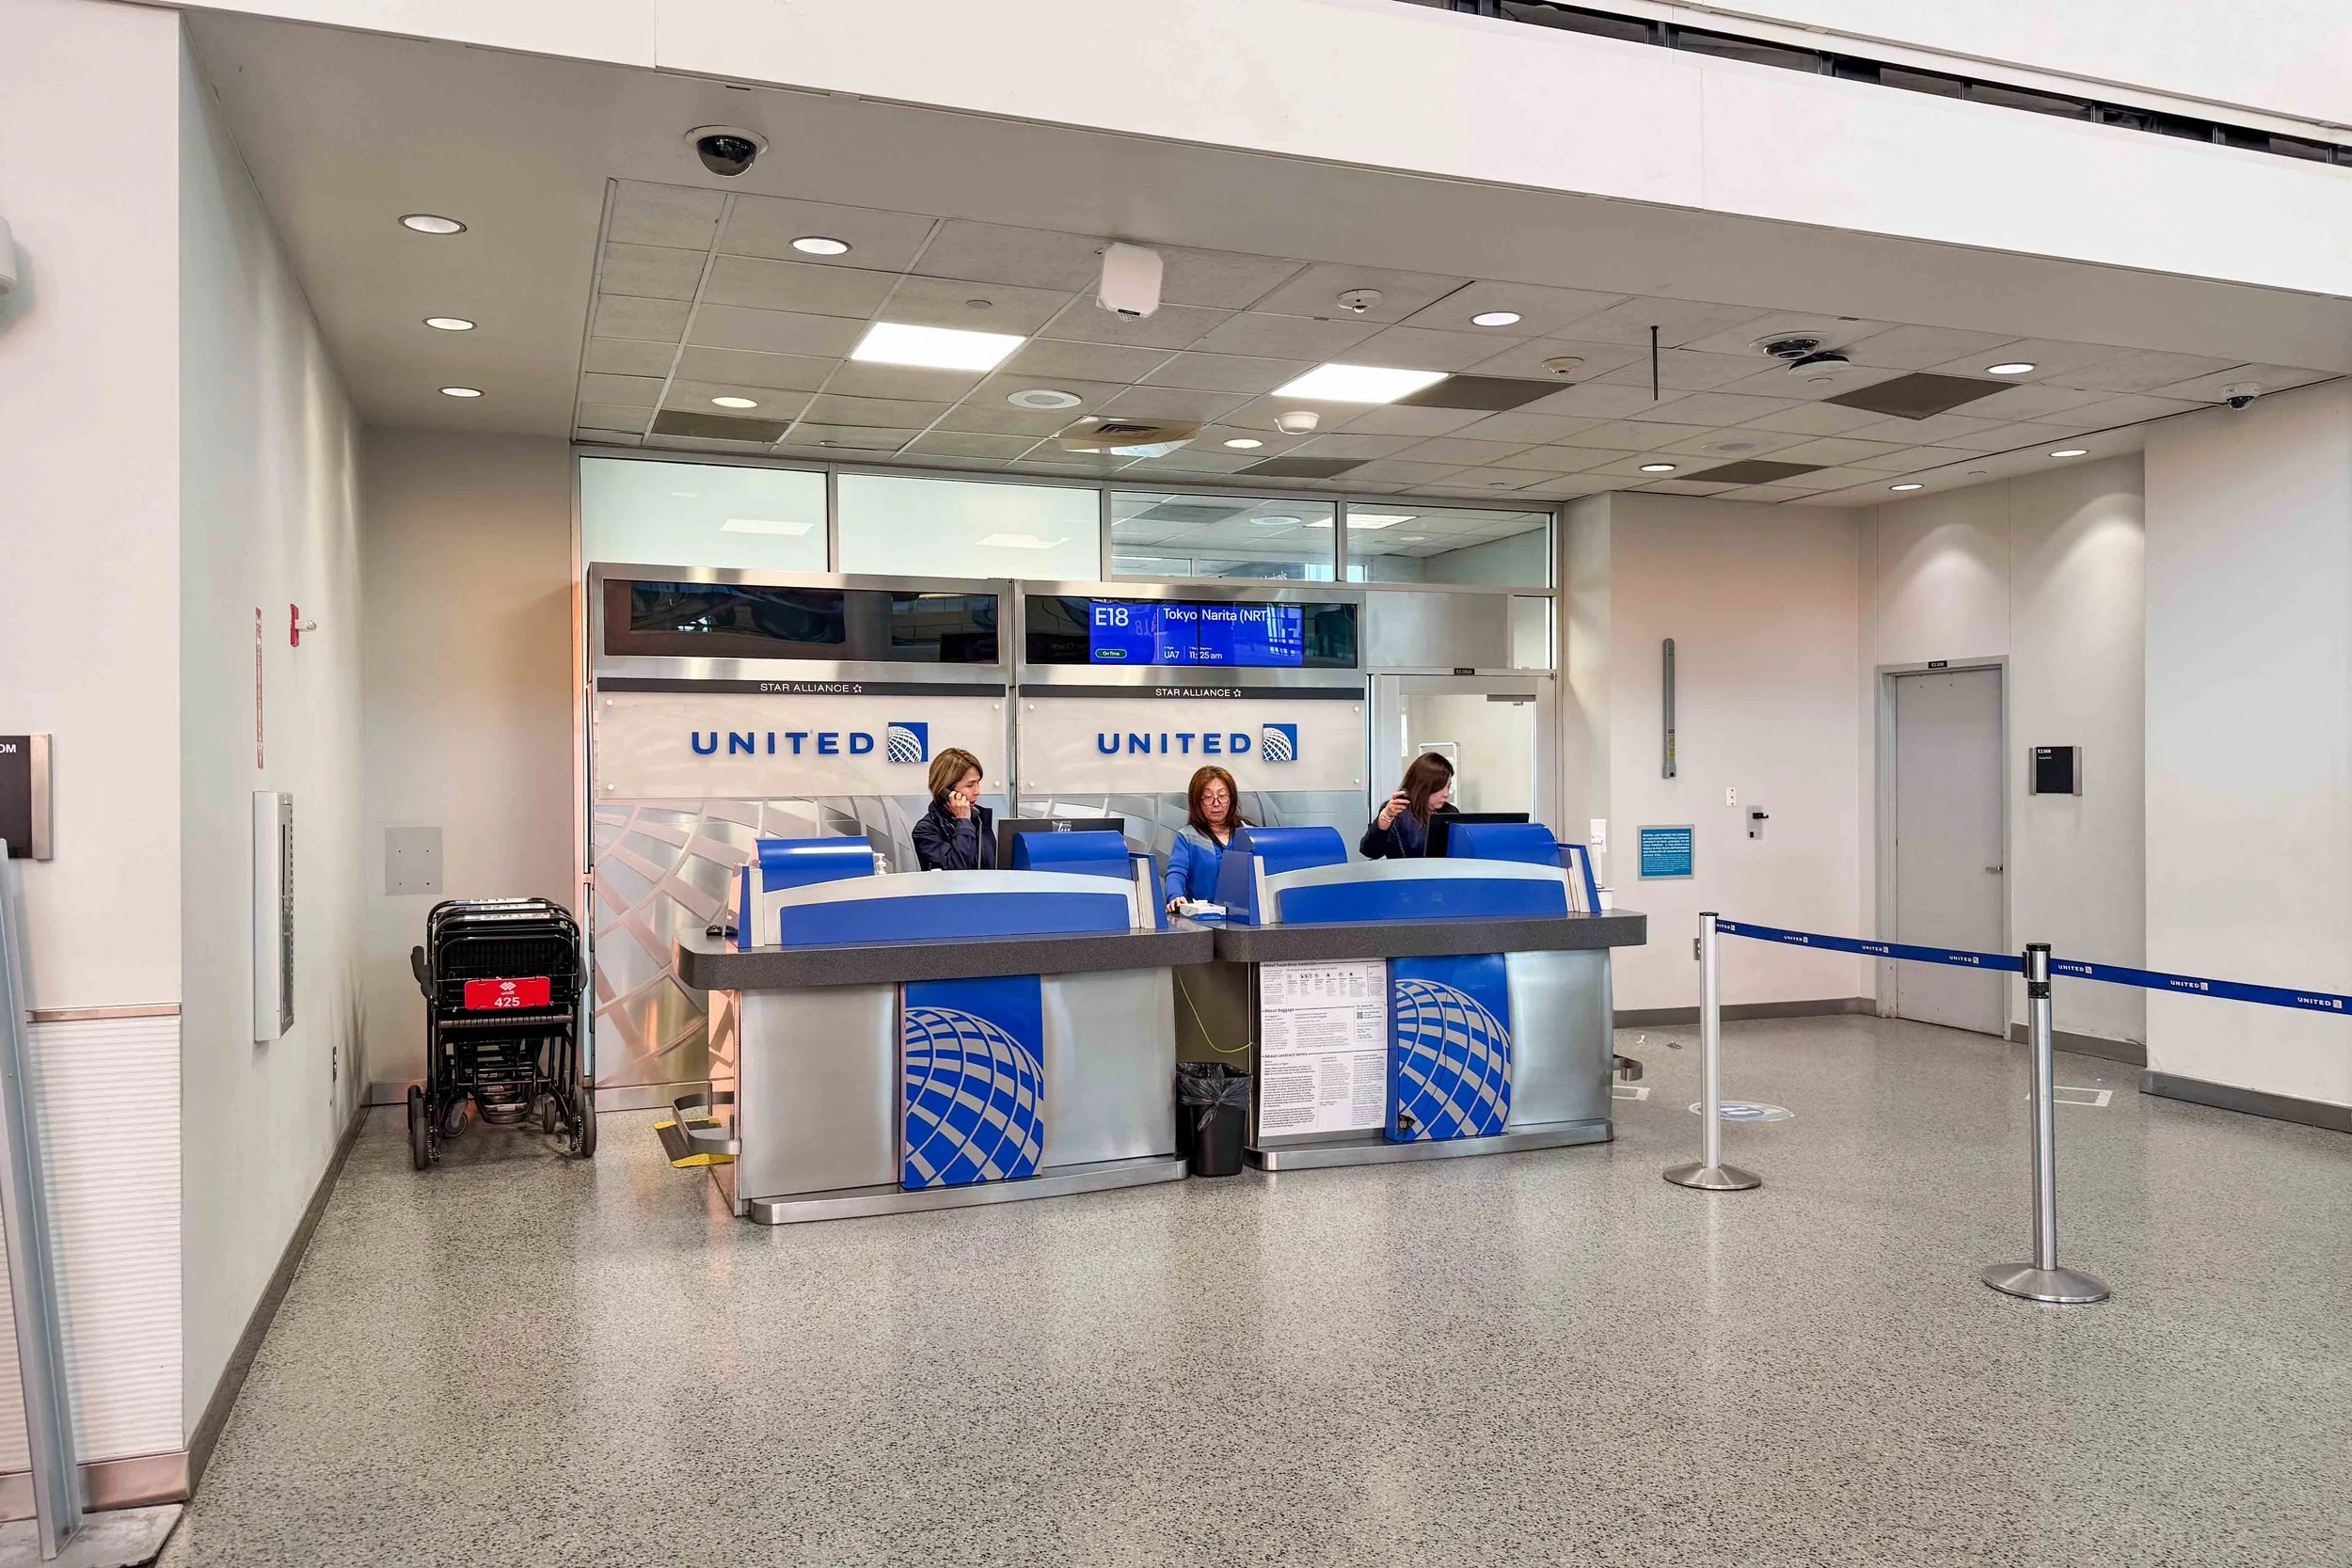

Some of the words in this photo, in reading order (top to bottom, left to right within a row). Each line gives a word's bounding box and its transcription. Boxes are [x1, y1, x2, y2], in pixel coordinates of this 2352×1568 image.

[1095, 607, 1129, 627] E18
[1163, 608, 1198, 623] Tokyo
[1201, 609, 1237, 622] Narita
[1239, 609, 1271, 624] (NRT
[1164, 651, 1180, 659] UA7
[759, 683, 790, 692] STAR
[793, 684, 850, 693] ALLIANCE
[1155, 688, 1180, 697] STAR
[1183, 689, 1231, 697] ALLIANCE
[691, 731, 875, 755] UNITED
[1097, 733, 1251, 754] UNITED
[2058, 964, 2085, 973] UNITED
[2169, 979, 2200, 989] UNITED
[494, 996, 520, 1007] 425
[2296, 996, 2331, 1006] UNITED
